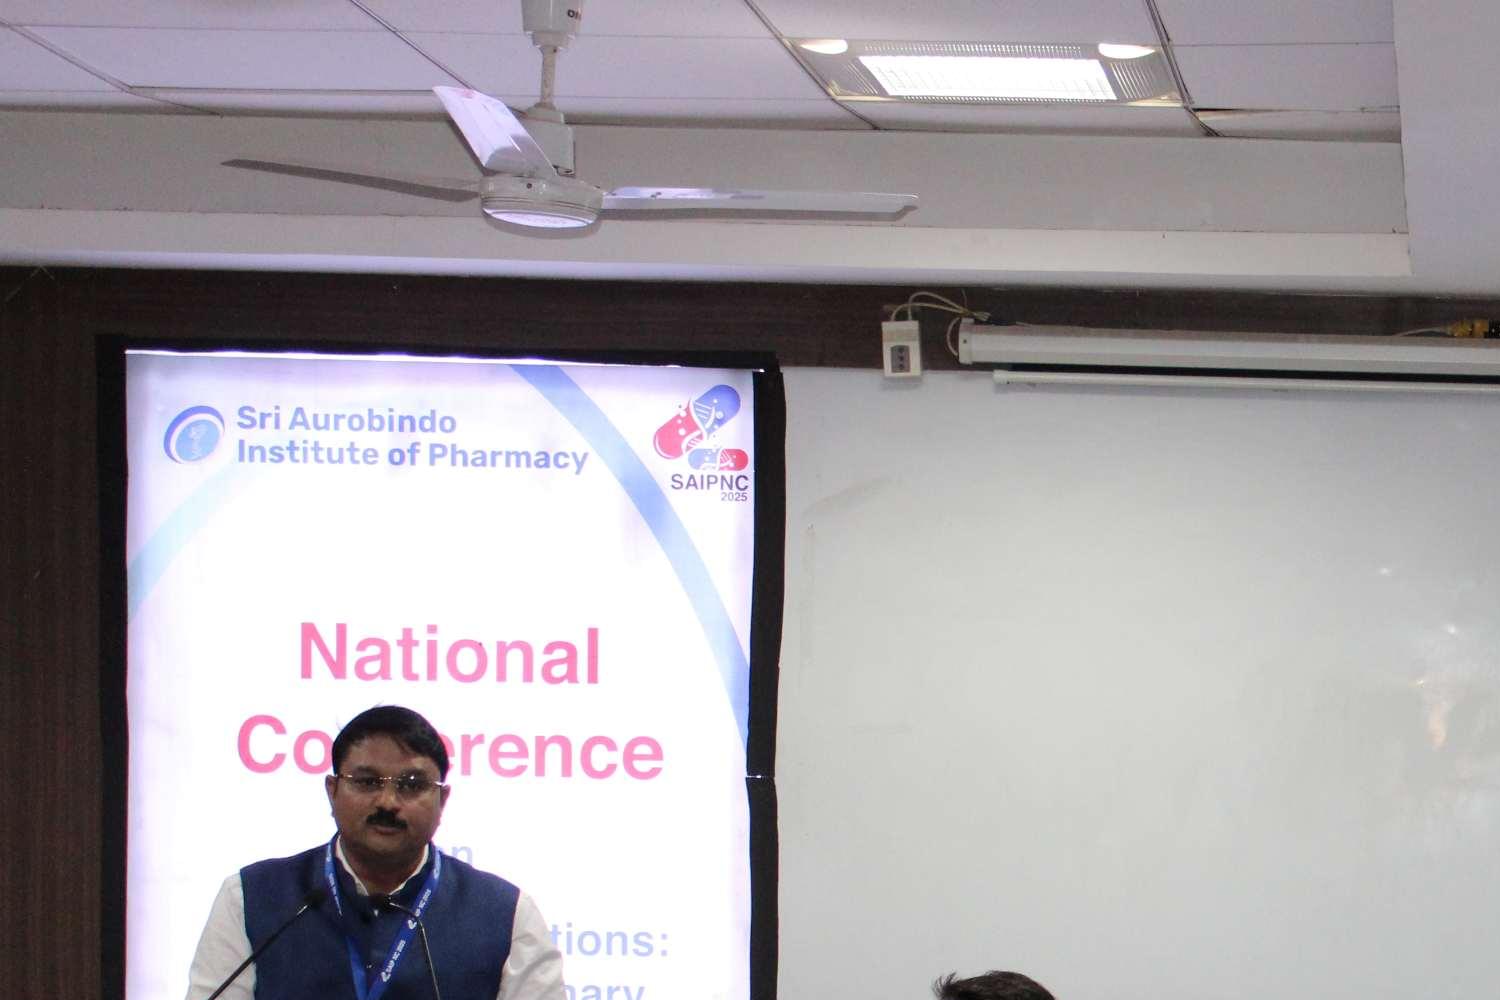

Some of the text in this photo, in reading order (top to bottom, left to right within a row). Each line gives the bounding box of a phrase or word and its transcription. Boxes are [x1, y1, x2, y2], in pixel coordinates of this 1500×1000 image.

[237, 405, 456, 433] Sri Aurobindo
[238, 440, 588, 474] Institute of Pharmacy
[671, 475, 749, 491] SAIPNC
[722, 491, 748, 501] 2025
[301, 622, 599, 685] National
[237, 714, 664, 780] Corence
